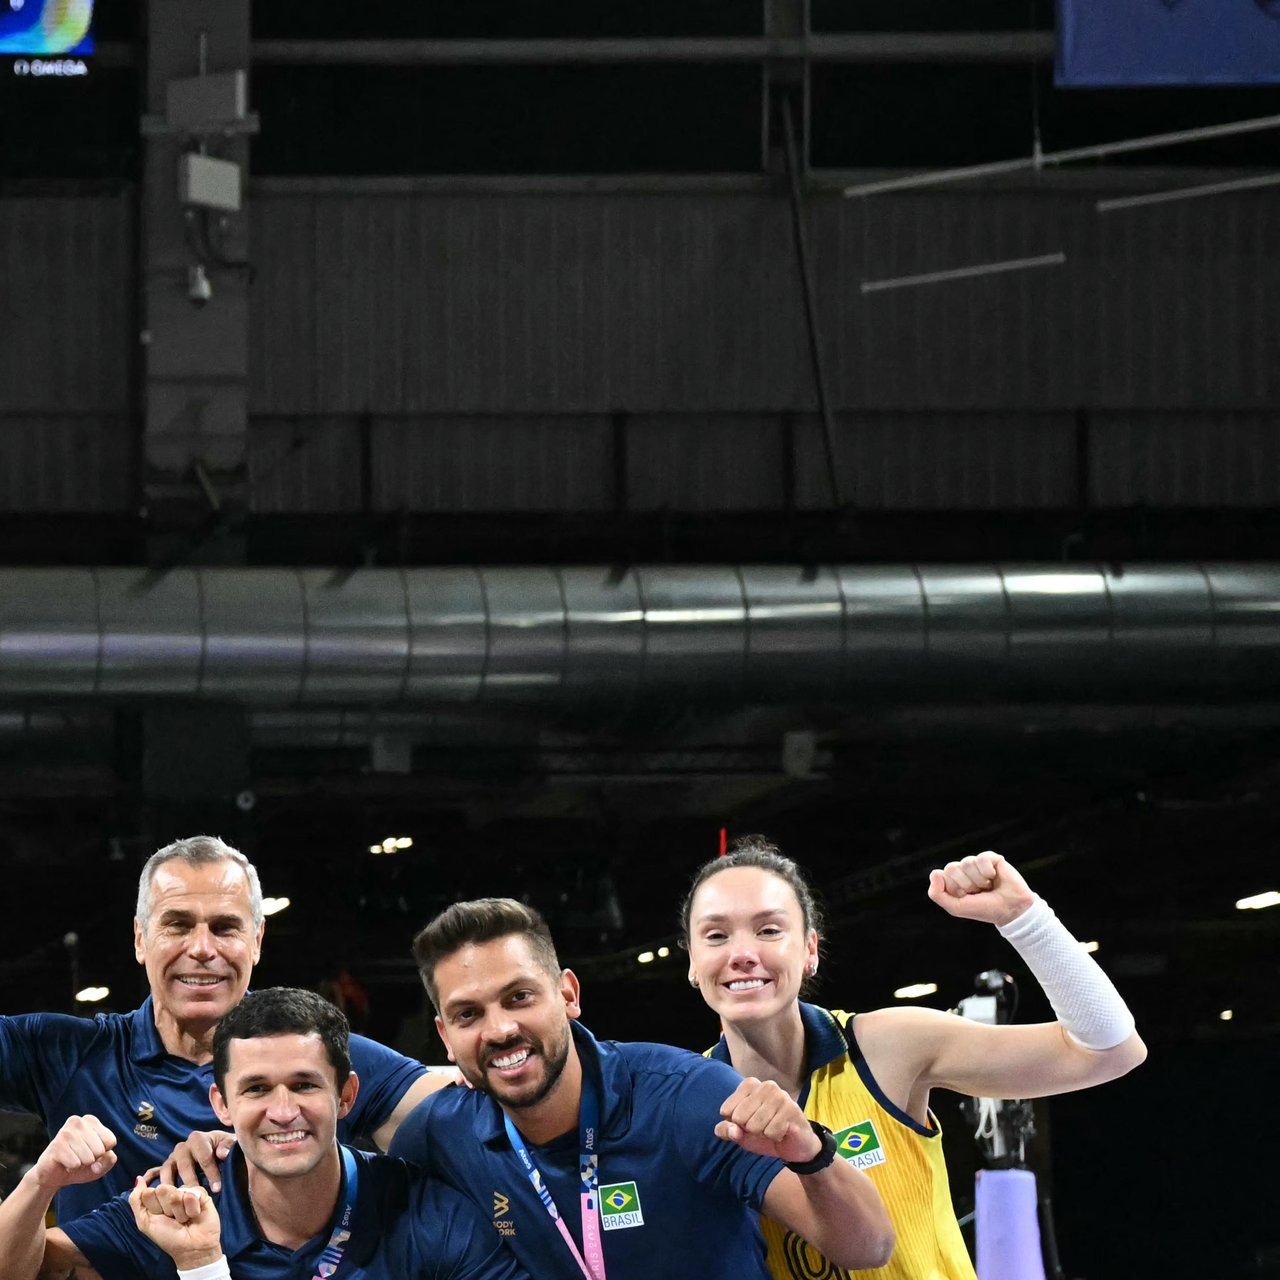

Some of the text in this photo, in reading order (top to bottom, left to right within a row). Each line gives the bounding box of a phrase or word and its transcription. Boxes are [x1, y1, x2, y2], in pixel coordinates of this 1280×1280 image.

[30, 59, 88, 77] OMEGA
[133, 1128, 159, 1140] WORK
[135, 1124, 158, 1134] BODY
[585, 1127, 594, 1151] Atos
[342, 1204, 352, 1226] Atos
[603, 1213, 643, 1229] BRASIL
[498, 1228, 516, 1236] ORK
